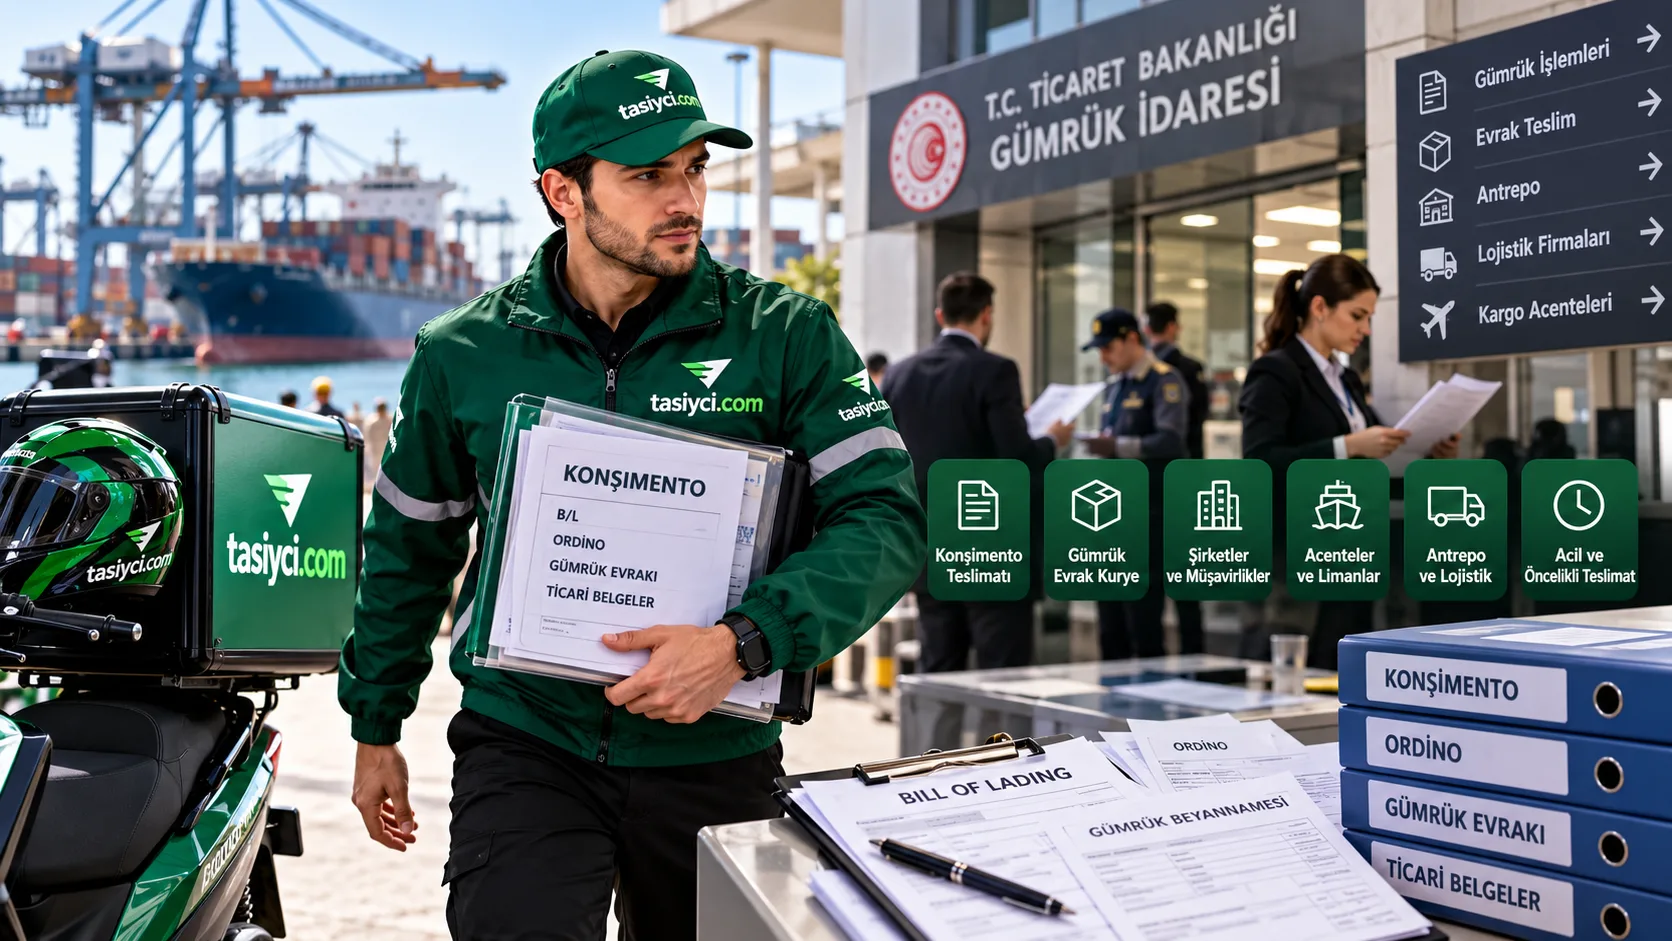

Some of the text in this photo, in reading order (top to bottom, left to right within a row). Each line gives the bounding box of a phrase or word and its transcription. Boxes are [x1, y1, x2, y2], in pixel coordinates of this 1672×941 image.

[984, 4, 1297, 121] T.C. TİCARET BAKANLIĞI
[1475, 38, 1610, 89] Gümrük İşlemleri
[618, 91, 701, 120] tasiyci.com
[990, 56, 1281, 171] GÜMRÜK İDARESİ
[1476, 110, 1576, 146] Evrak Teslim
[1477, 180, 1541, 204] Antrepo
[1478, 228, 1610, 265] Lojistik Firmaları
[1479, 292, 1612, 326] Kargo Acenteleri
[650, 392, 763, 417] tasiyci.com
[563, 464, 706, 497] KONŞIMENTO
[556, 508, 579, 523] B/L
[227, 531, 346, 586] tasiyci.com
[553, 533, 605, 551] ORDİNO
[87, 551, 173, 583] tasiyci.com
[549, 559, 658, 583] GÜMRÜK EVRAKI
[547, 584, 655, 608] TİCARİ BELGELER
[1385, 668, 1519, 701] KONŞİMENTO
[1173, 739, 1228, 752] ORDİNO
[1385, 734, 1462, 763] ORDİNO
[898, 767, 1073, 805] BILL OF LADING
[1089, 795, 1289, 838] GÜMRÜK BEYANNAMESİ
[1385, 796, 1545, 845] GÜMRÜK EVRAKI
[1386, 857, 1541, 912] TİCARİ BELGELER
